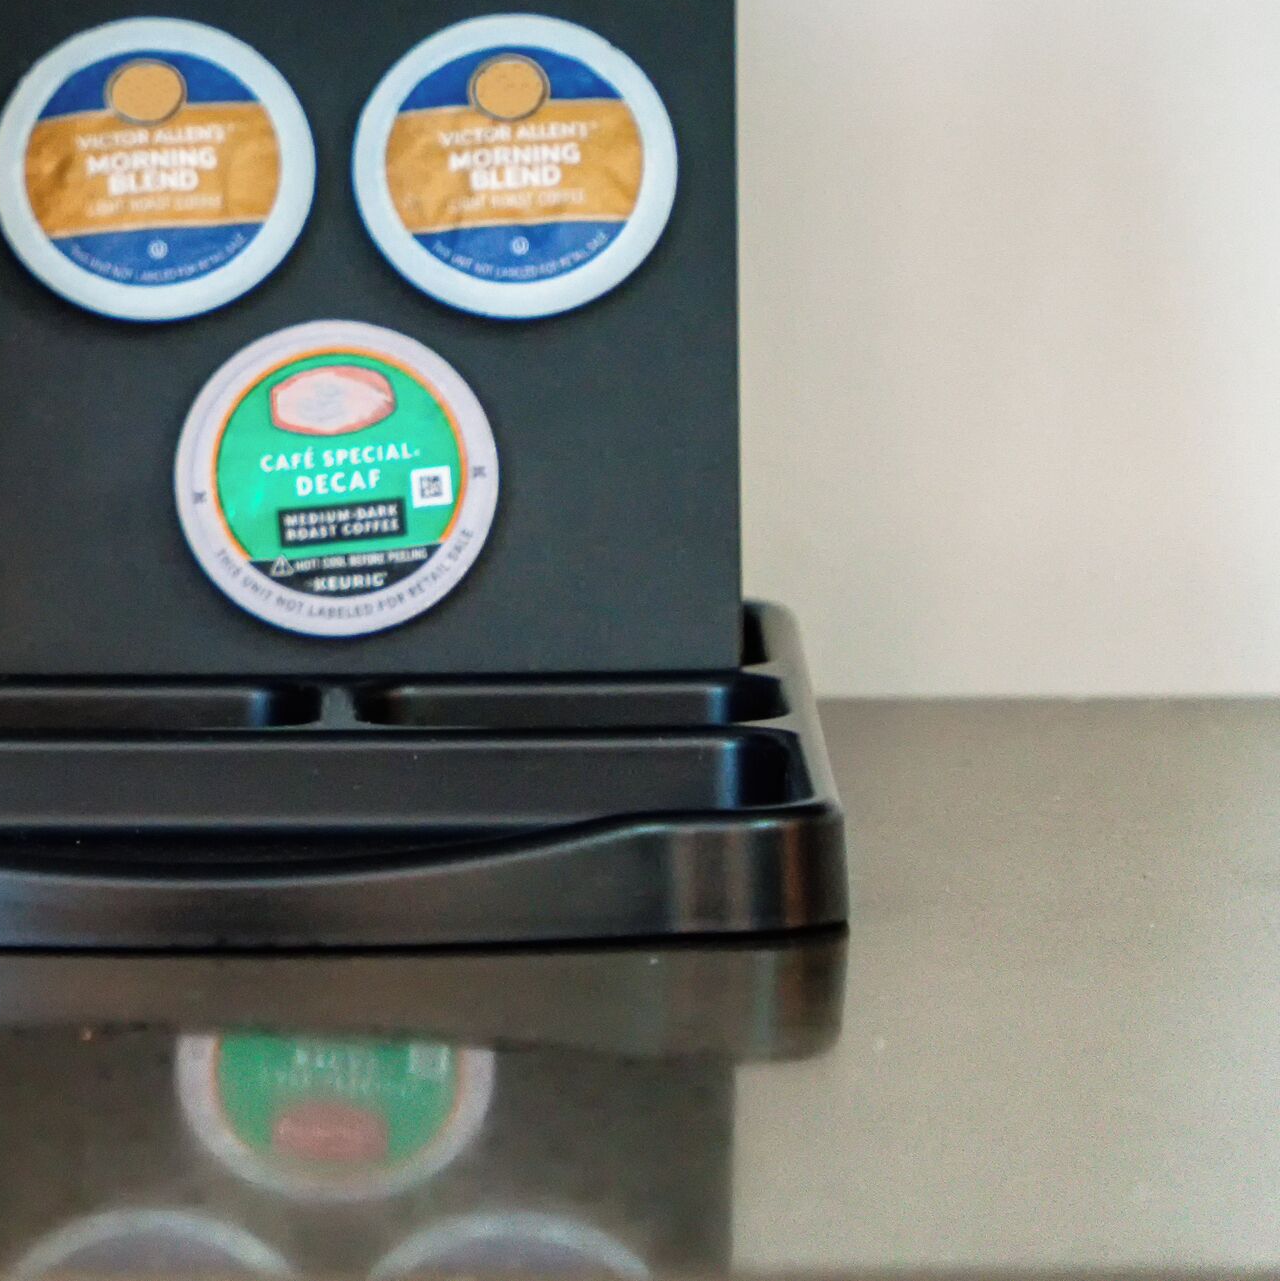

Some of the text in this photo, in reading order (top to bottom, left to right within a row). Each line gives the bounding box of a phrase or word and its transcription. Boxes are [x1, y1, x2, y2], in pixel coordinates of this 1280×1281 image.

[85, 146, 218, 176] MORNING
[449, 142, 581, 171] MORNING
[107, 168, 199, 196] BLEND
[470, 165, 562, 192] BLEND
[260, 446, 315, 472] CAFÉ
[296, 469, 381, 496] DECAF
[286, 519, 400, 541] ROAST COFFEE
[313, 573, 385, 592] KEURIG
